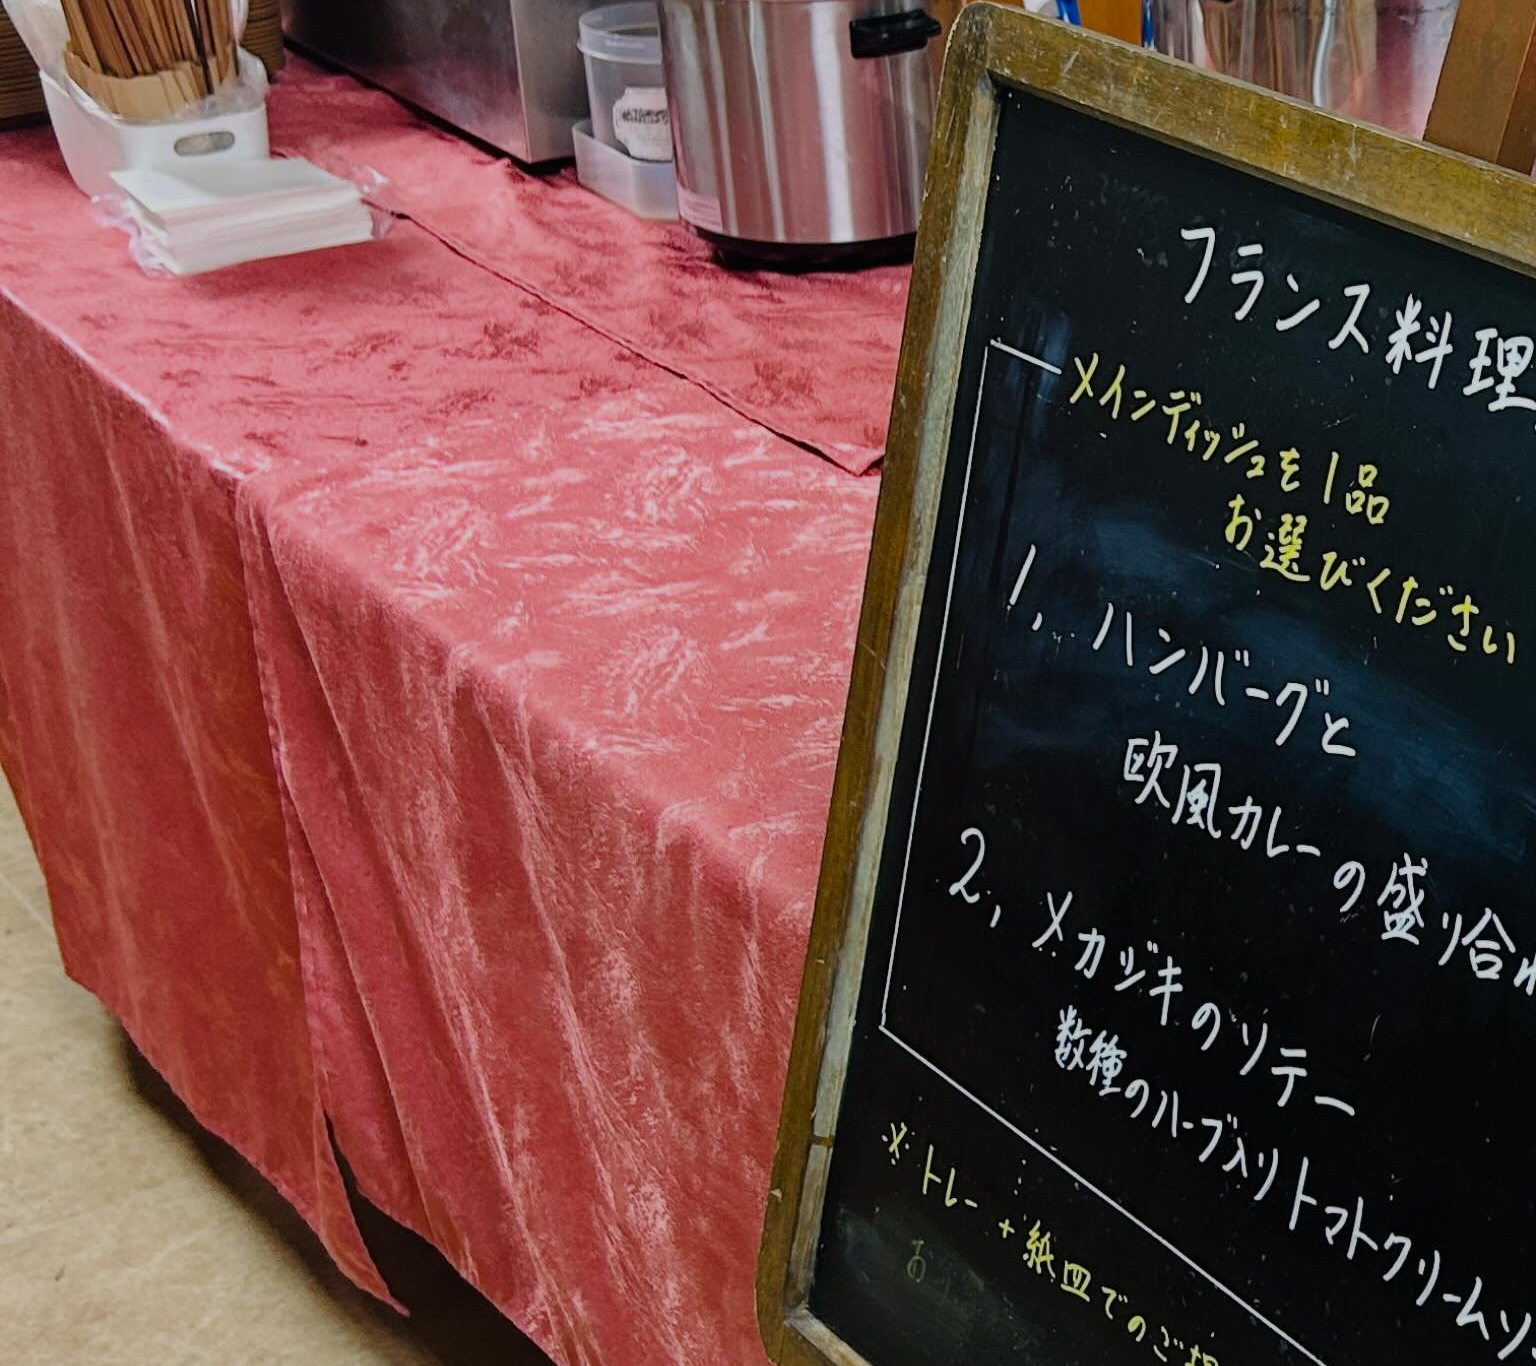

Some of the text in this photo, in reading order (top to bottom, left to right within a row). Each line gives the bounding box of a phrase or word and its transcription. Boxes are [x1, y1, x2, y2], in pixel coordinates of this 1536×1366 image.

[1225, 493, 1515, 664] お選びください
[1092, 602, 1356, 758] ハンバーグと
[1032, 891, 1355, 1116] メカジキのソテー
